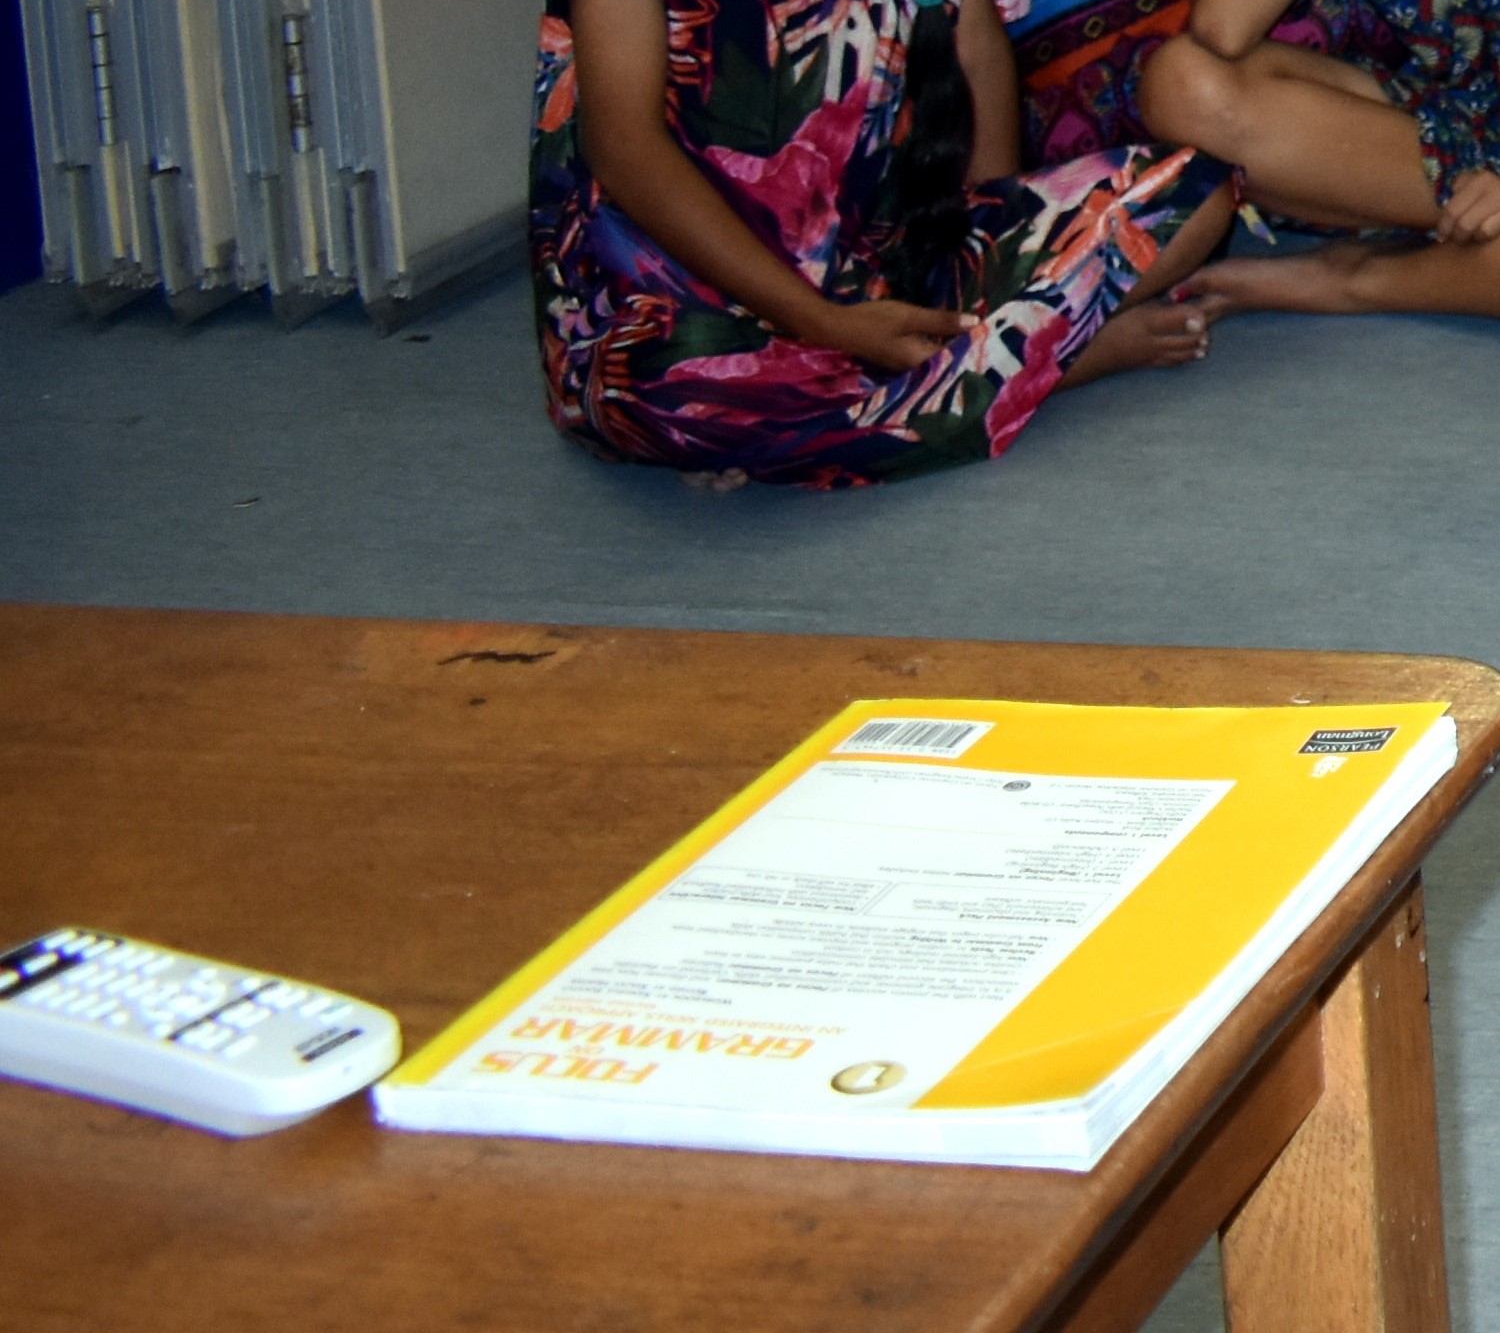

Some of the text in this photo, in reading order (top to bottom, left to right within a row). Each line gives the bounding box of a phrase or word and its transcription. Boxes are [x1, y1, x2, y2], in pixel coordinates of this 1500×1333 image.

[1313, 730, 1392, 738] Longman
[1301, 742, 1382, 752] PEARSON
[504, 1017, 818, 1058] GRAMMAR
[465, 1051, 662, 1085] FOCUS
